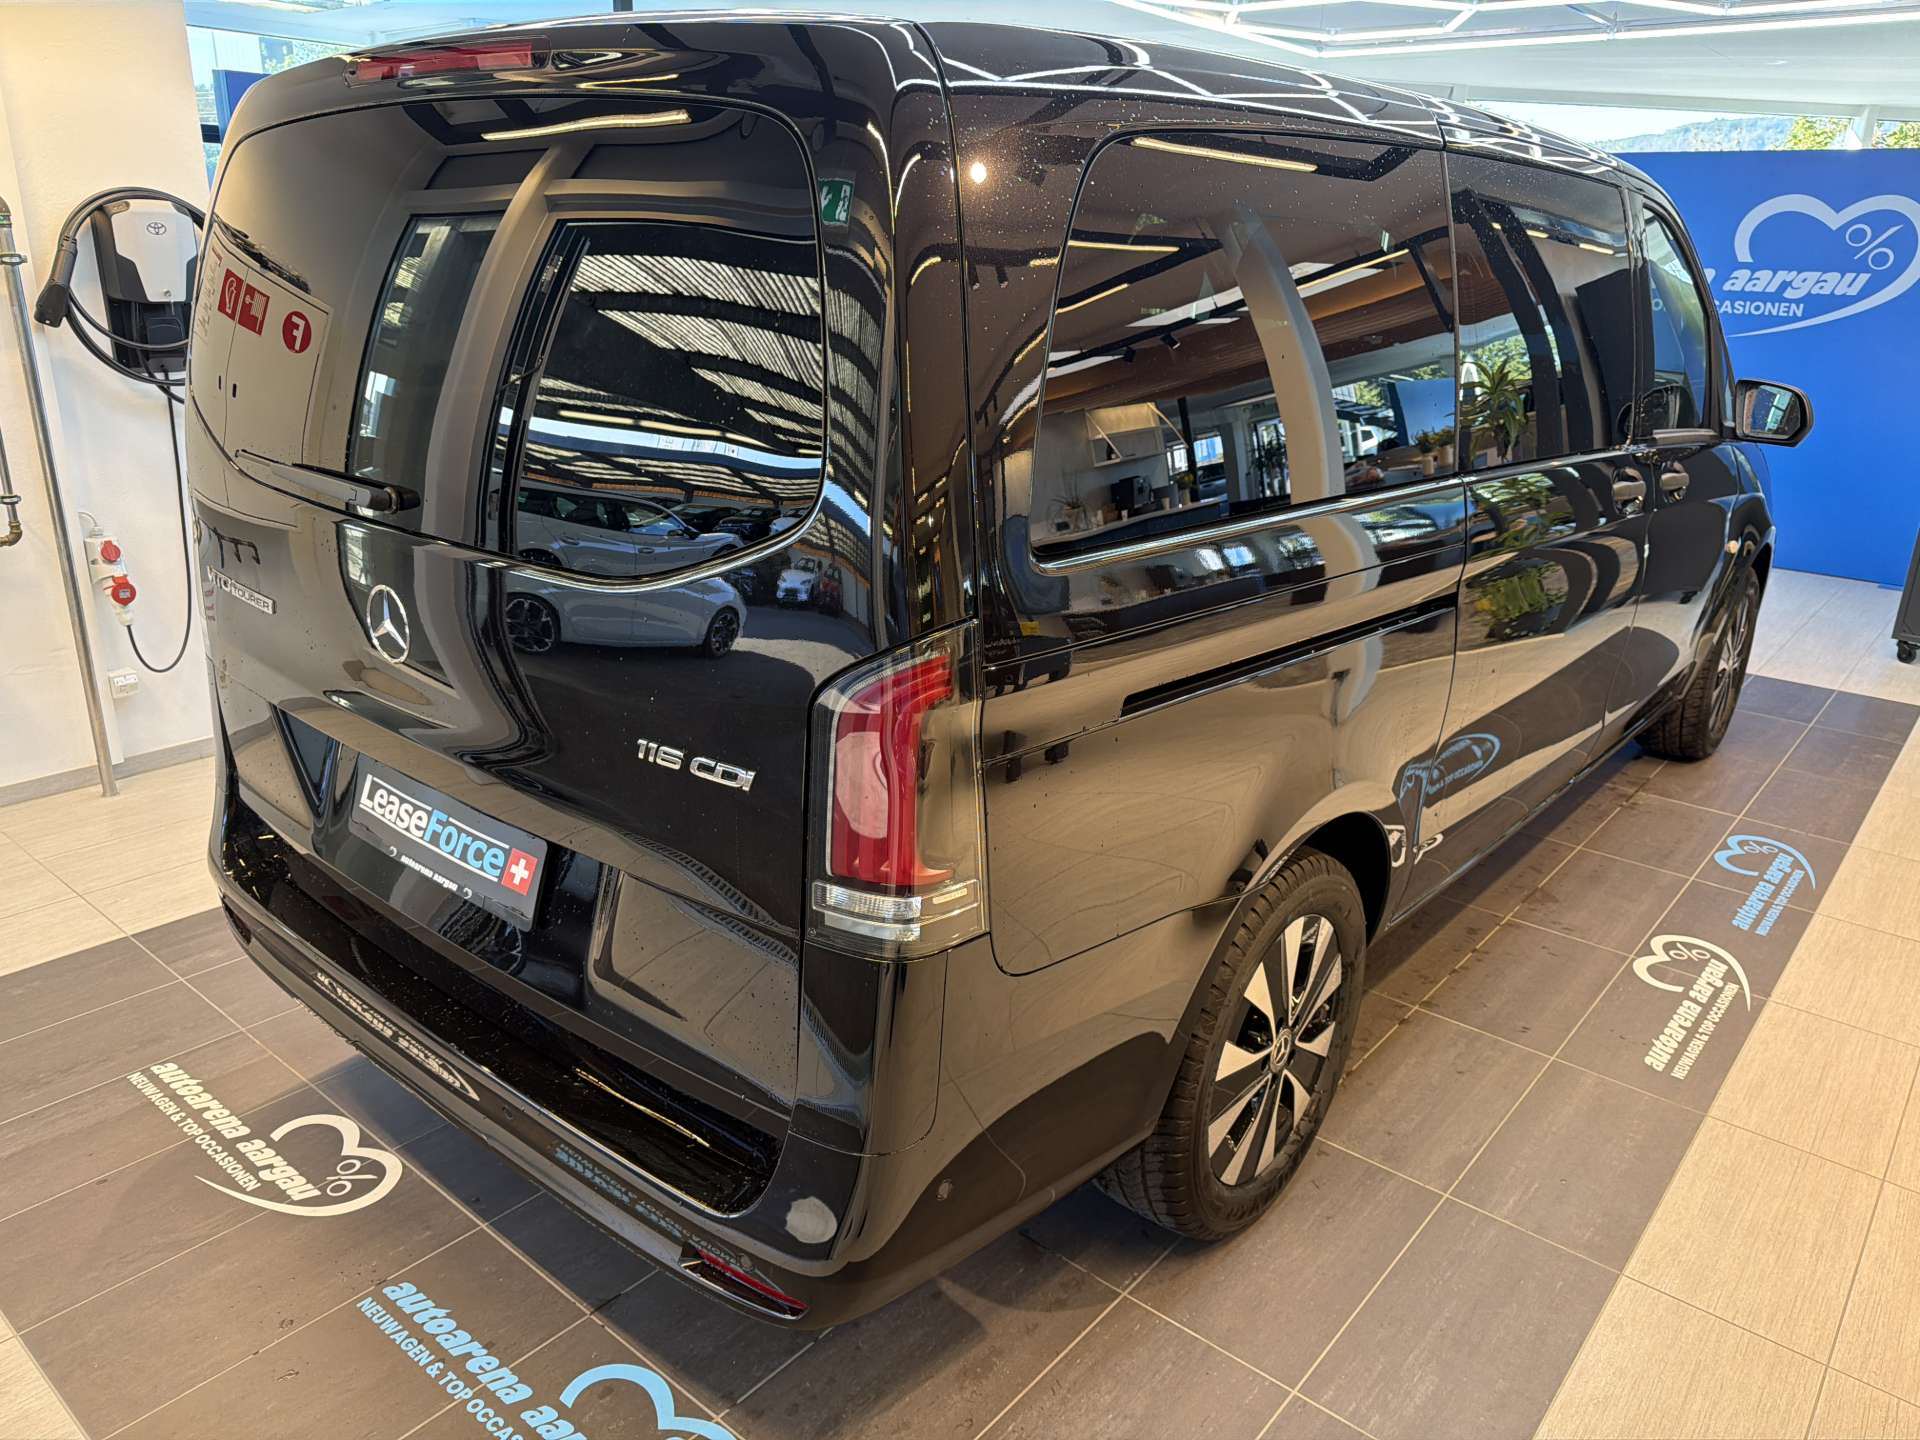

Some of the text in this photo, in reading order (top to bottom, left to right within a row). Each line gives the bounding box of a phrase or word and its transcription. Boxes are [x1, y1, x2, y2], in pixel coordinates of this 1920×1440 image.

[1713, 300, 1804, 317] ASIONEN
[1723, 268, 1872, 299] aargau
[232, 582, 272, 611] TOURER
[637, 739, 756, 792] 116 CDI
[360, 773, 505, 877] LeaseForce
[1644, 958, 1729, 1072] autoarena aargau
[1670, 1038, 1706, 1080] NEUWAGEN
[1698, 1019, 1717, 1036] TOP
[126, 1072, 261, 1192] NEUWAGEN & TOP OCCASIONEN
[150, 1062, 322, 1201] autoarena aargau
[356, 1296, 435, 1367] NEUWAGEN
[425, 1361, 444, 1379] &
[438, 1371, 473, 1400] TOP
[382, 1281, 534, 1405] autoarena
